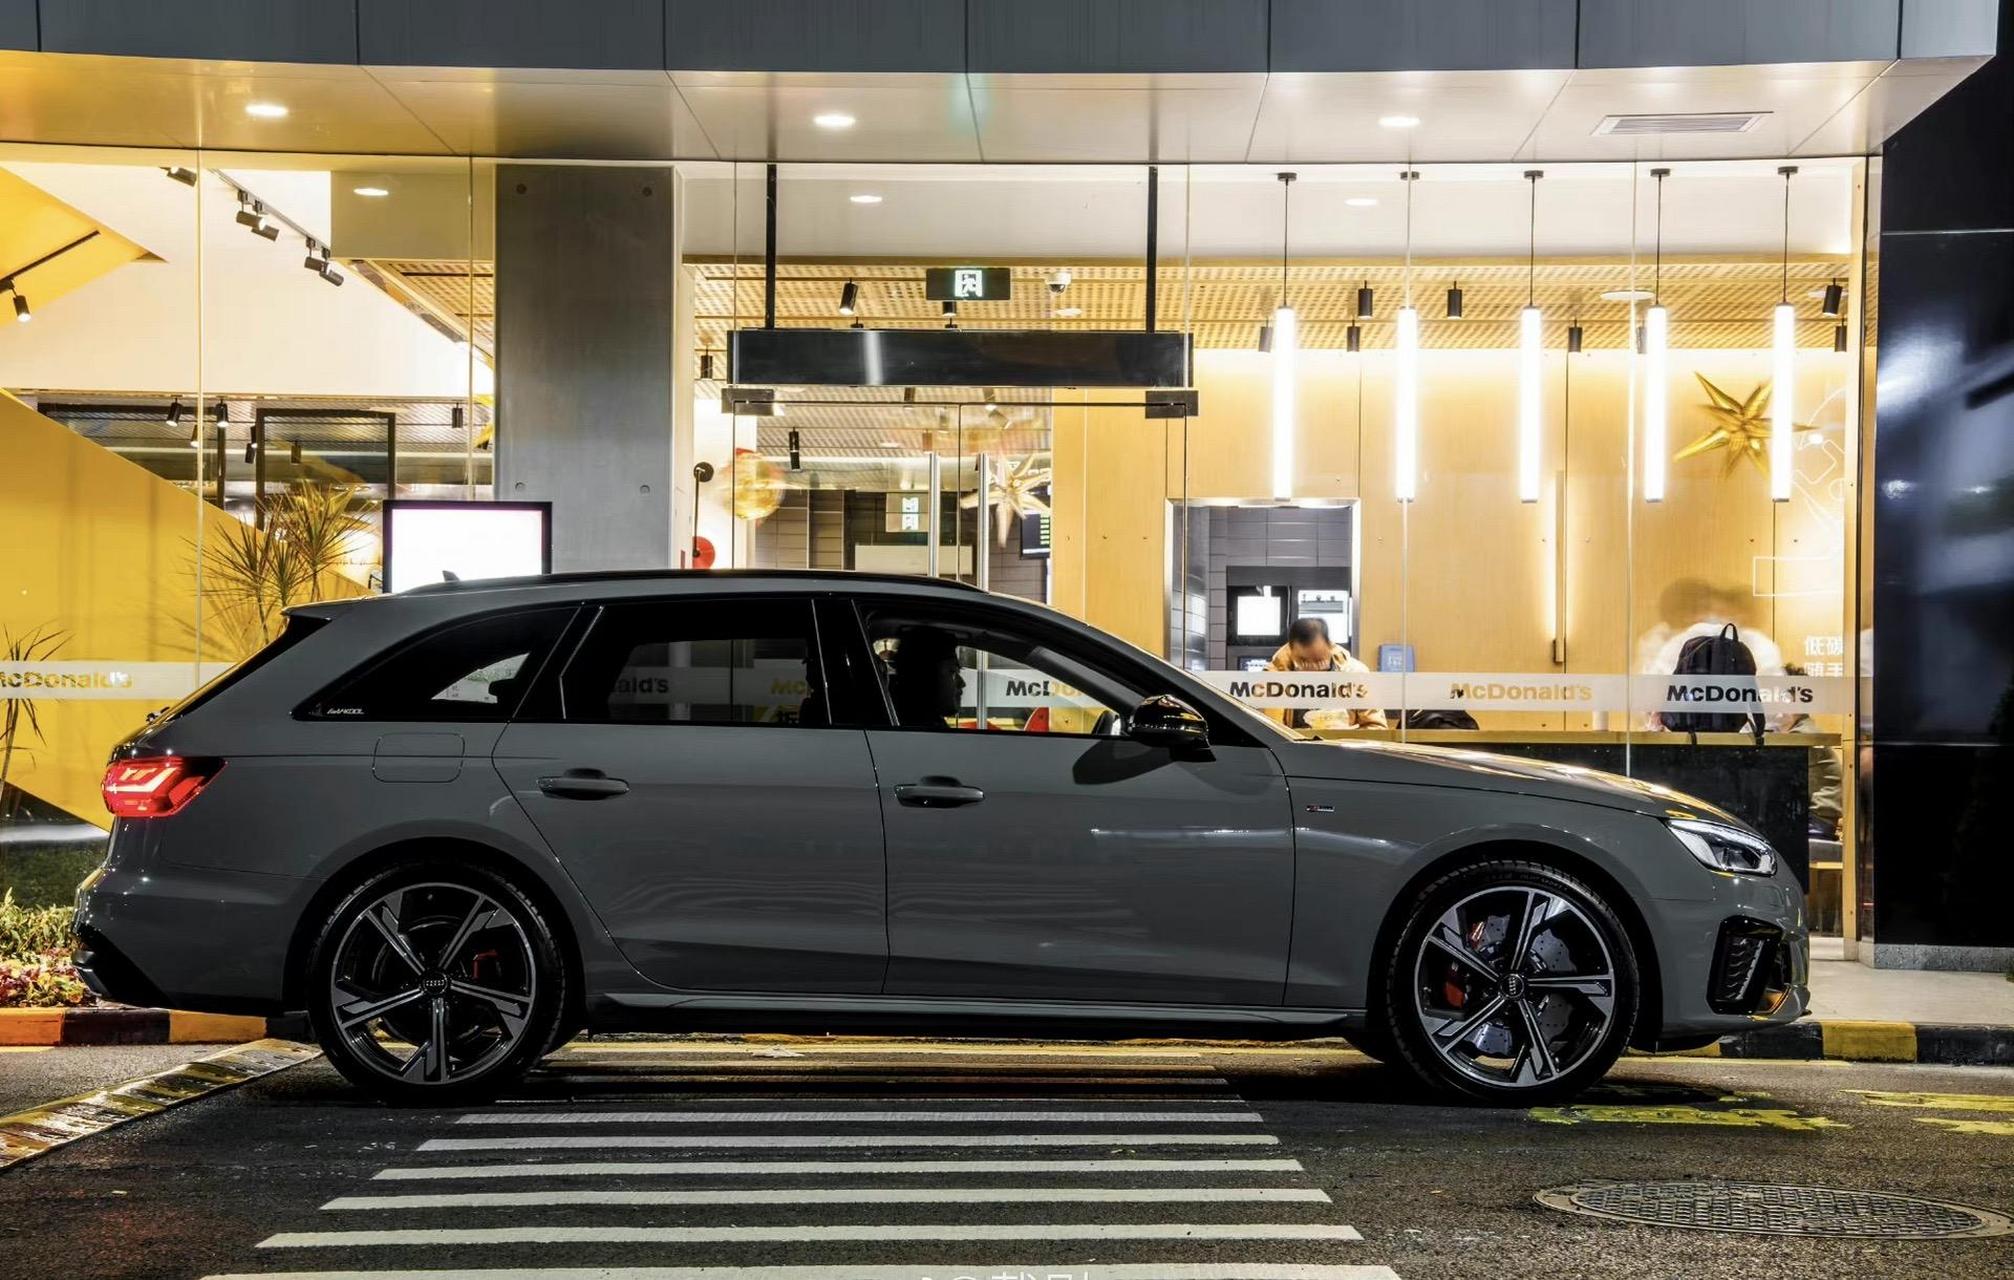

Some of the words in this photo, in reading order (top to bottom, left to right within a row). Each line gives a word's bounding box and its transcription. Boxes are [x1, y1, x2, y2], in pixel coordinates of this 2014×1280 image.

[1229, 681, 1369, 699] McDonald's
[1450, 682, 1592, 700] McDonald's
[1666, 685, 1814, 703] McDonald's
